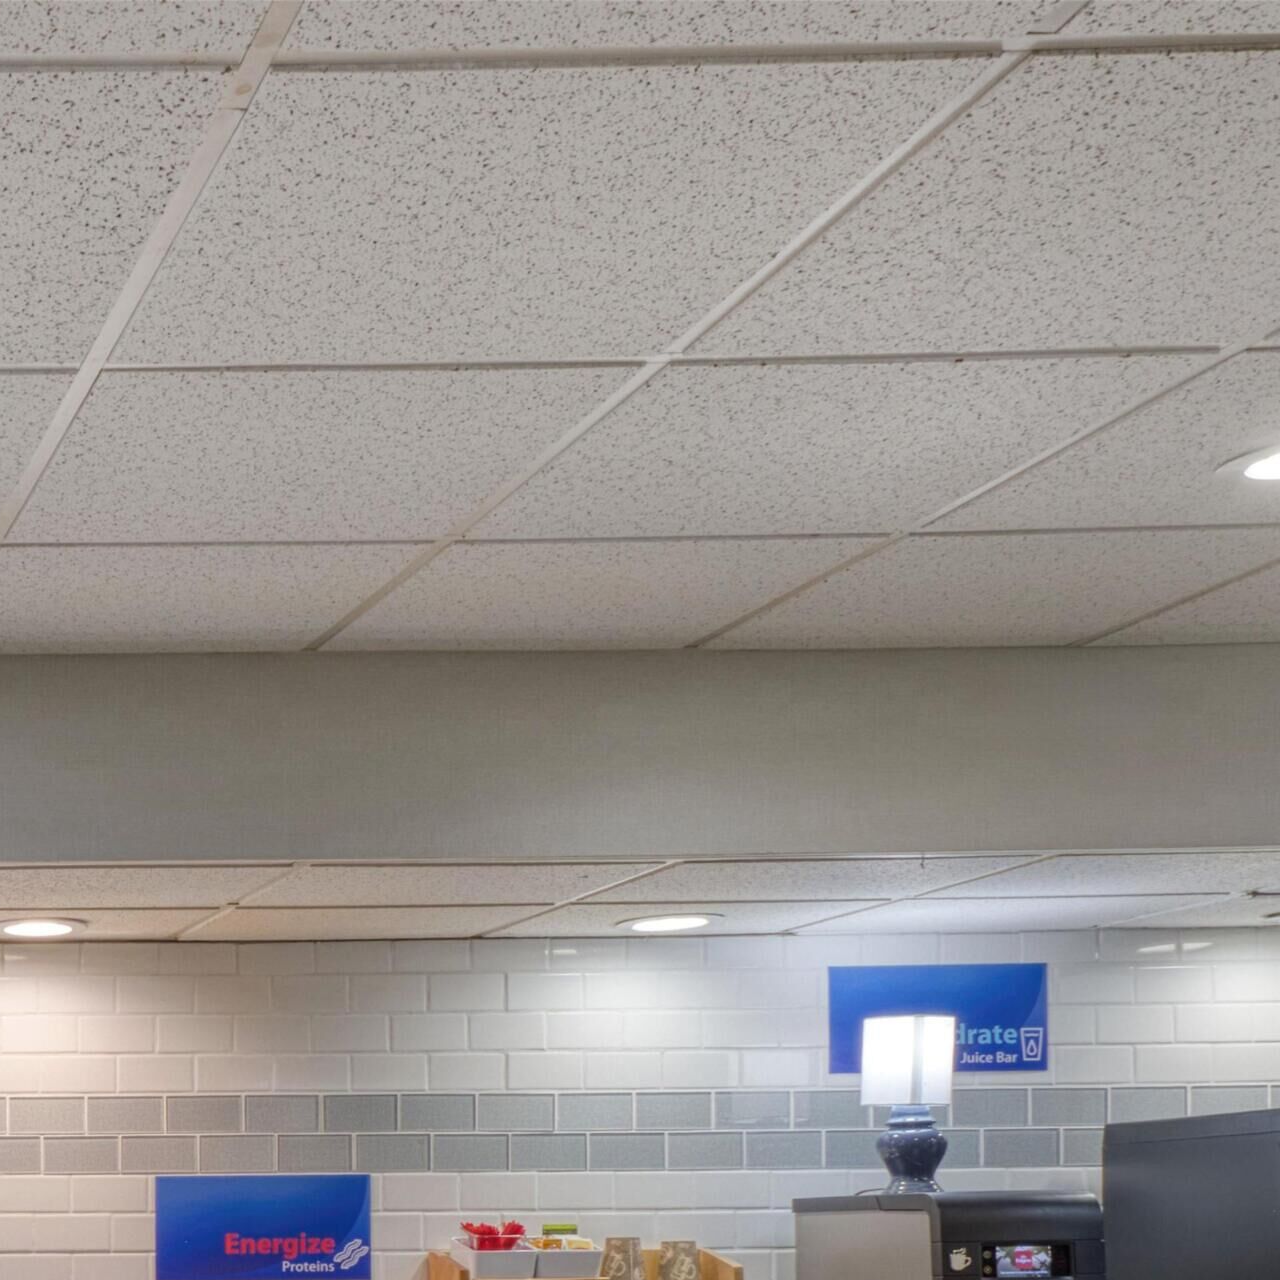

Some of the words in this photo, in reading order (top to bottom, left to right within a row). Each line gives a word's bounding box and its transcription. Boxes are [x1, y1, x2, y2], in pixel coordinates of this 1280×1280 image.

[955, 1023, 1018, 1045] drate
[960, 1052, 993, 1064] Juice
[995, 1052, 1018, 1063] Bar
[224, 1232, 336, 1260] Energize
[282, 1260, 335, 1273] Proteins
